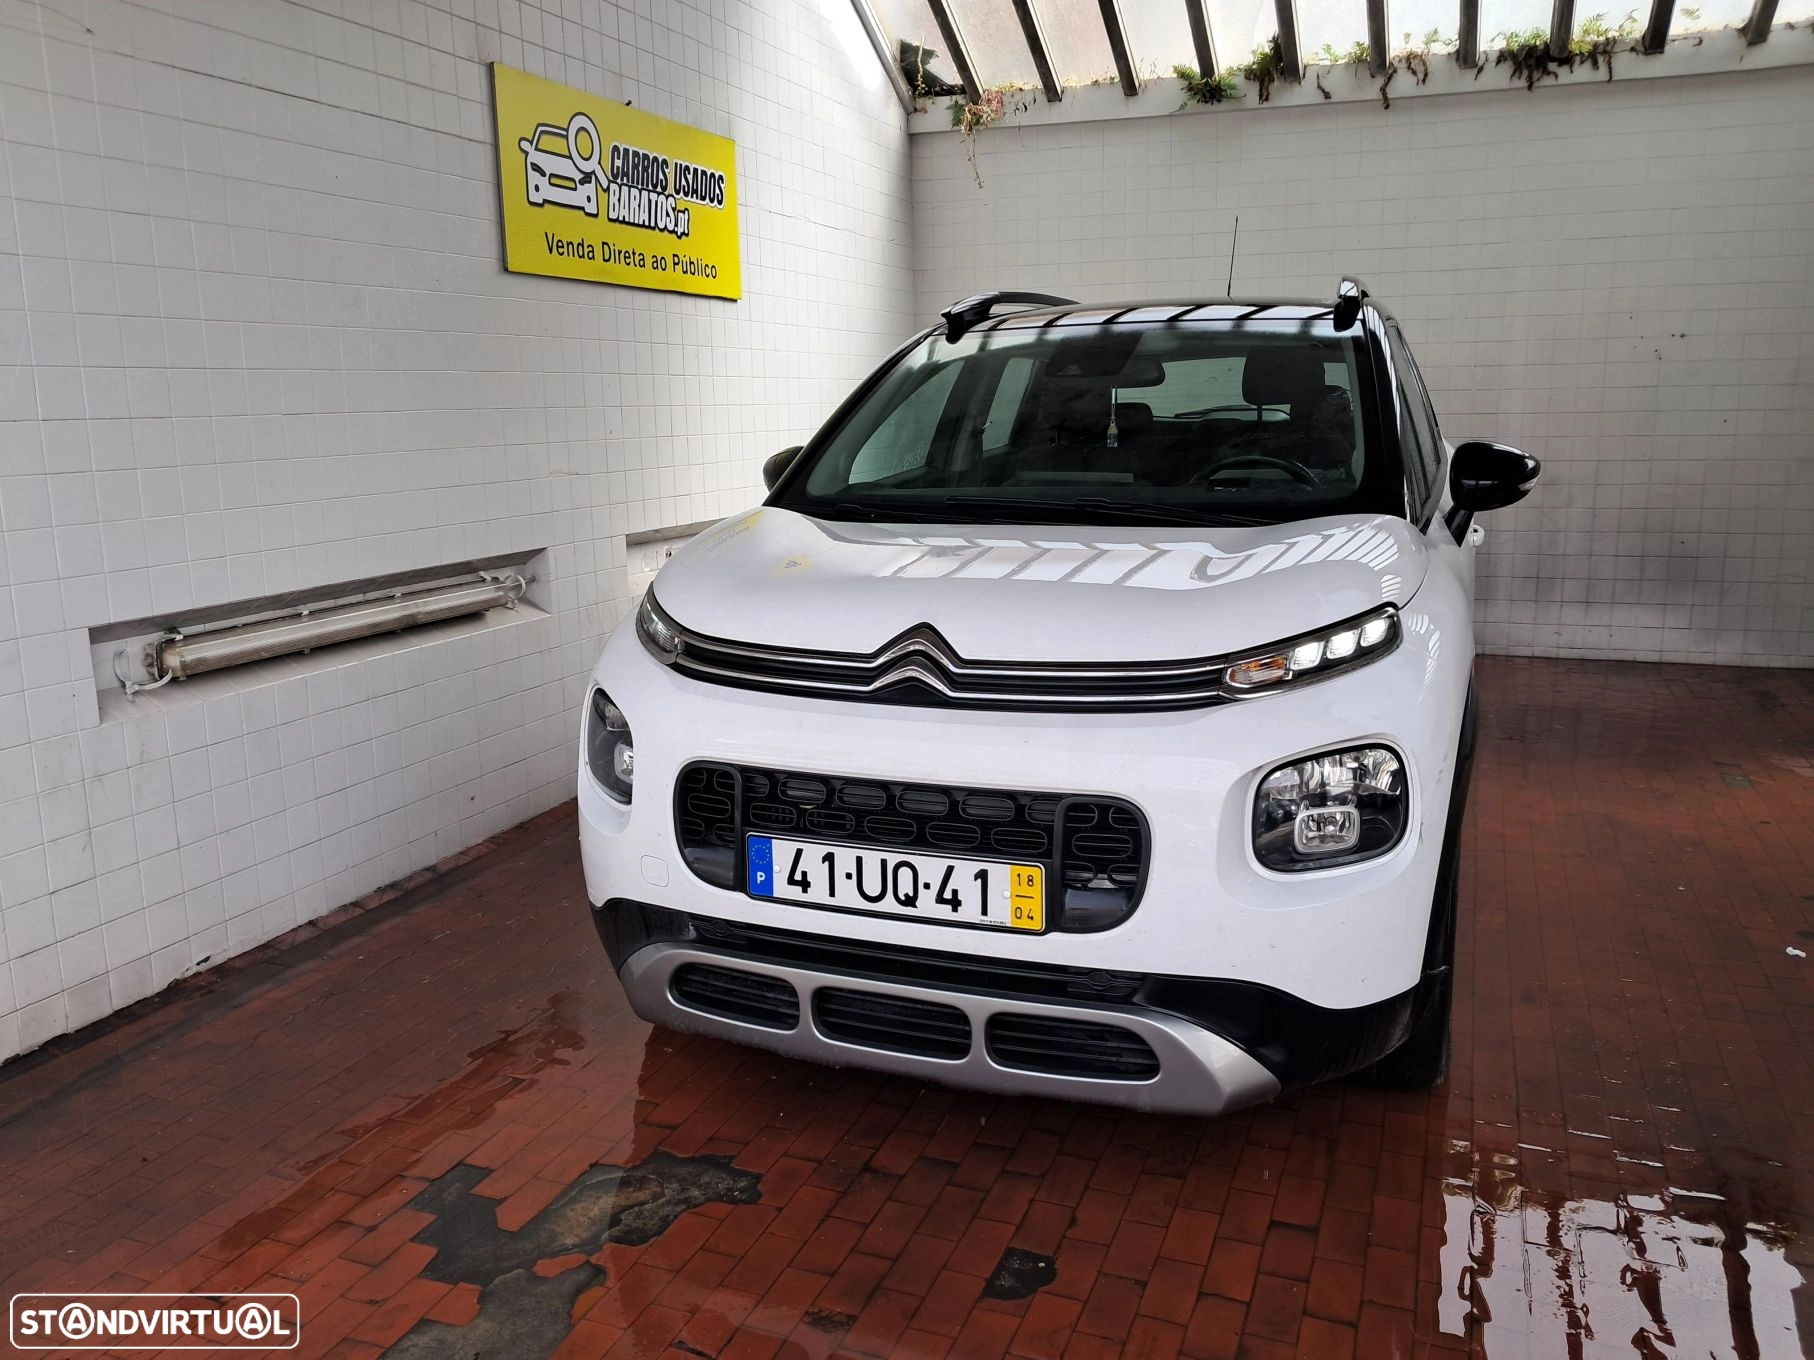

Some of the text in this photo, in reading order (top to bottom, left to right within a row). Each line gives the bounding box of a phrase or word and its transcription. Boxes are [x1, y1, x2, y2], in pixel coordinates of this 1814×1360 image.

[609, 144, 725, 206] CARROS USADOS
[608, 183, 690, 238] BARATOS.pt
[544, 232, 718, 279] Venda Direta ao Público
[756, 872, 766, 884] P
[1016, 873, 1035, 887] 18
[1014, 906, 1035, 921] 04
